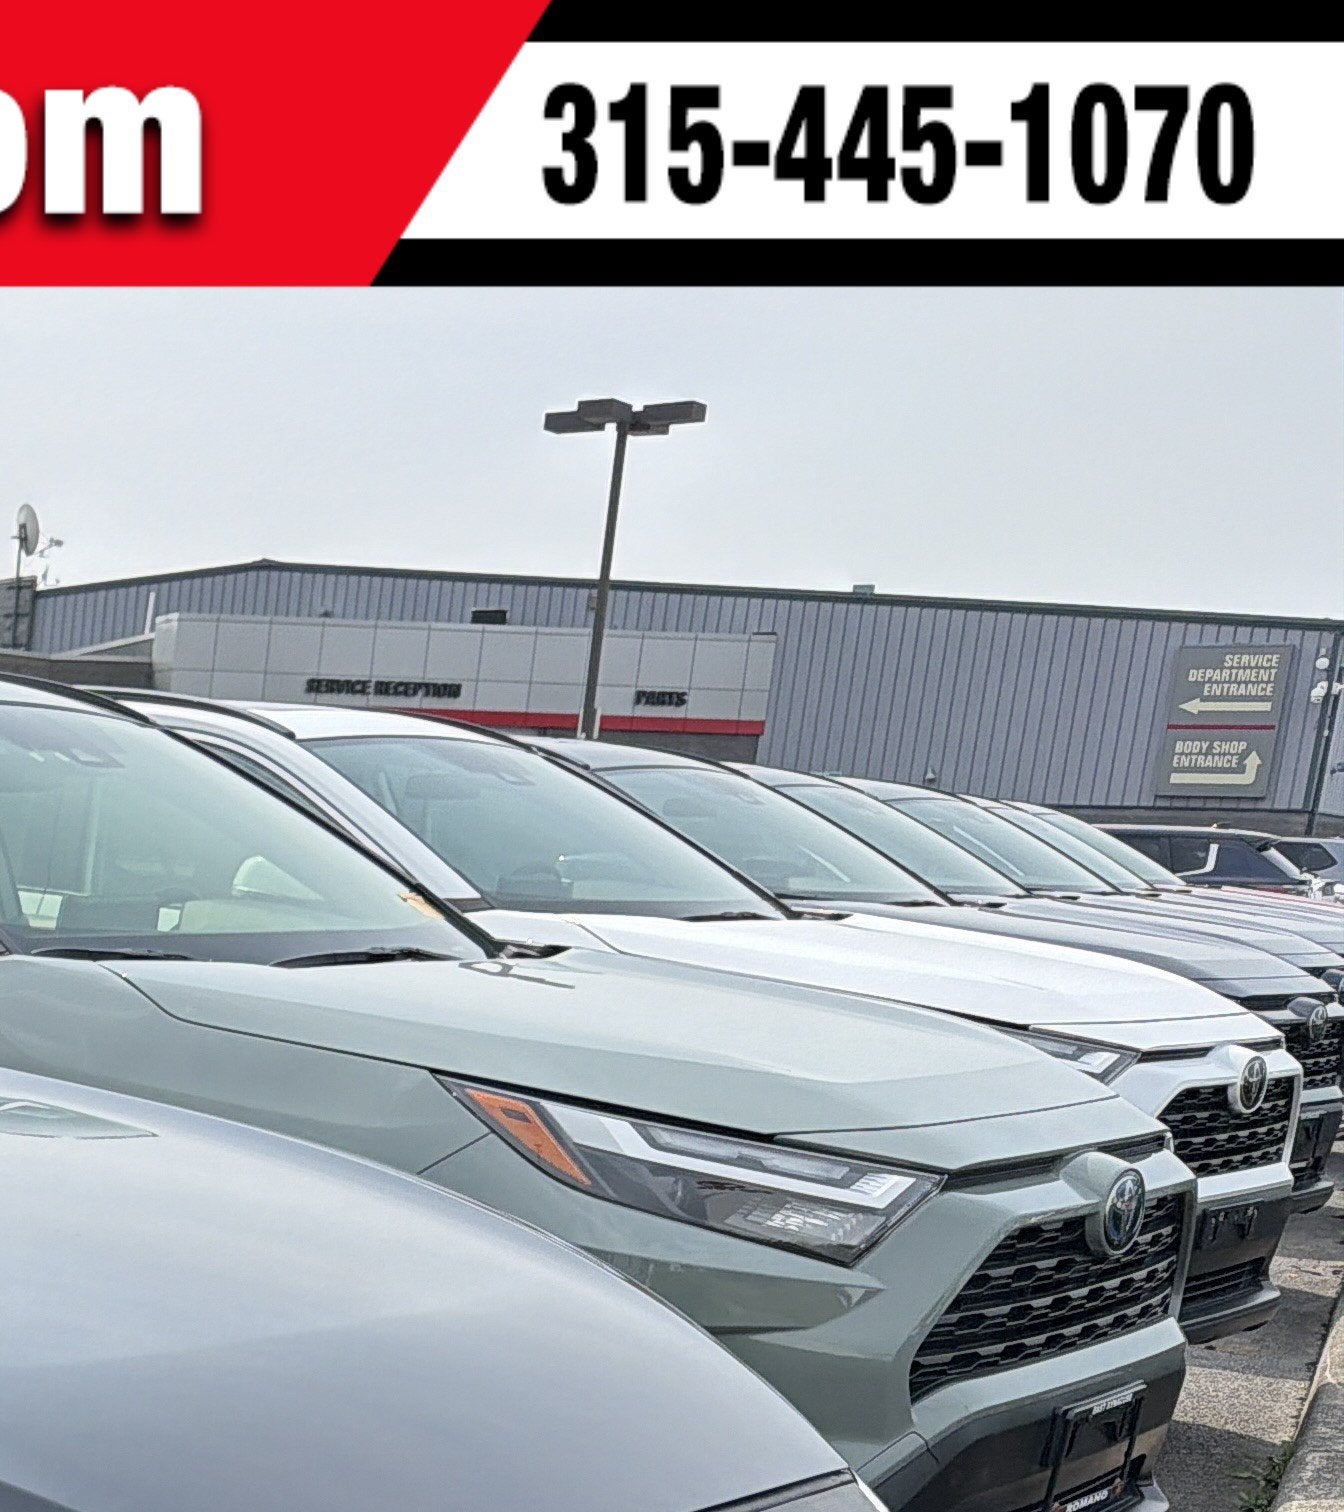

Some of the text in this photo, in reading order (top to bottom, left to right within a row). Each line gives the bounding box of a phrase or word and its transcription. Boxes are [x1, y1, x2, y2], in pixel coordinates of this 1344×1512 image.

[1224, 654, 1280, 667] SERVICE
[1188, 668, 1277, 681] DEPARTMENT
[306, 678, 462, 698] SERVICE RECEPTION
[1203, 683, 1274, 696] ENTRANCE
[634, 690, 688, 707] PARTS
[1175, 741, 1247, 753] BODY SHOP
[1172, 754, 1240, 767] ENTRANCE
